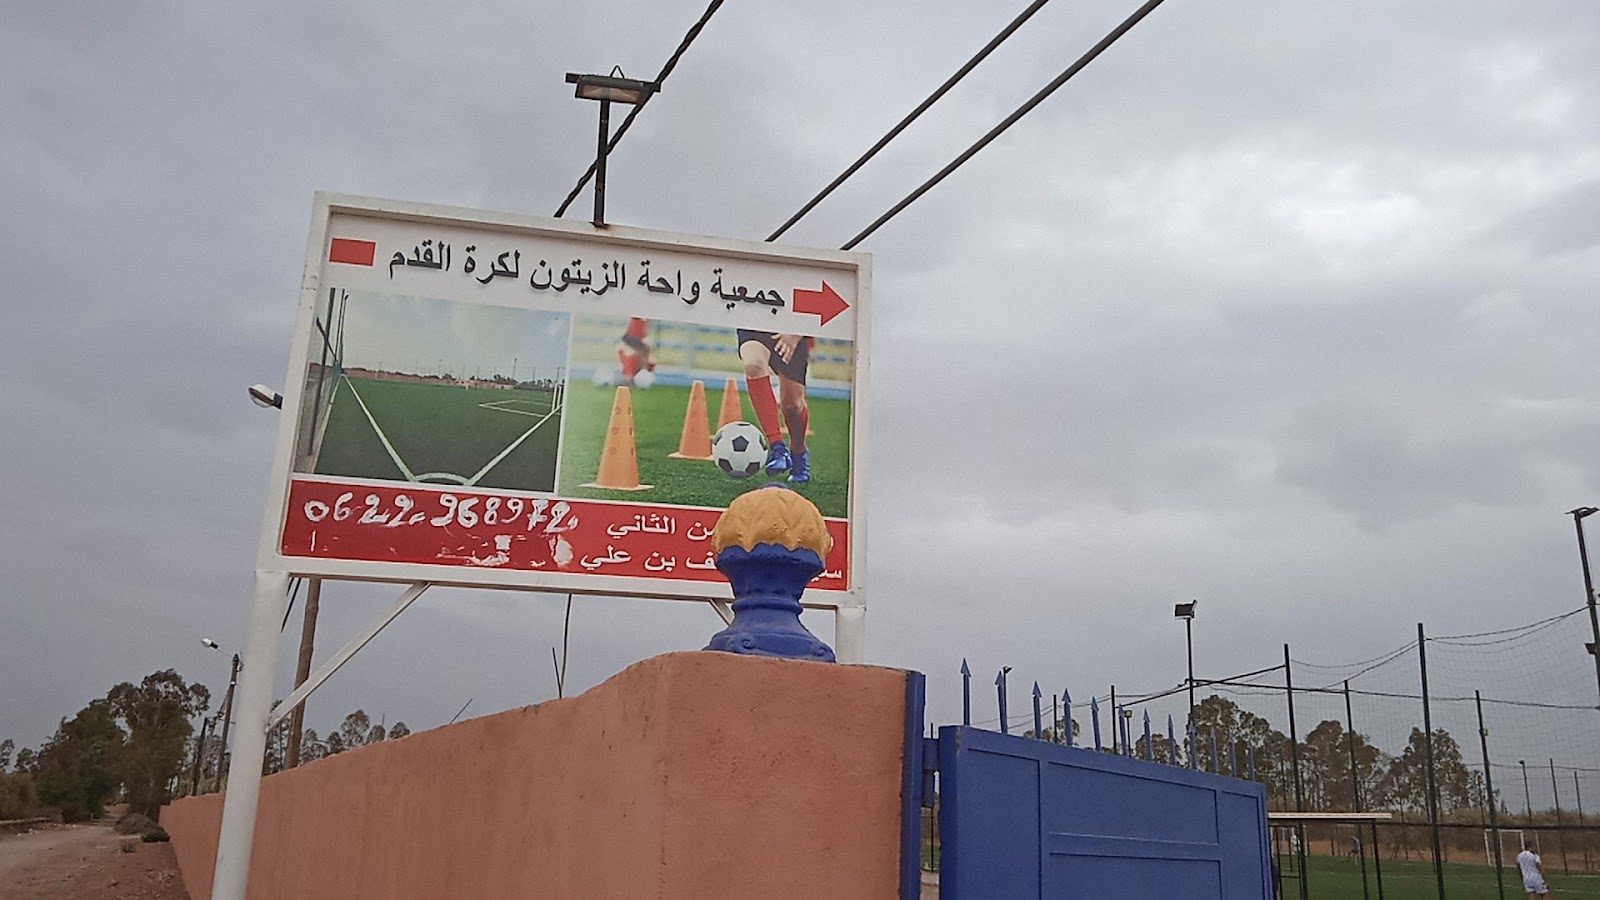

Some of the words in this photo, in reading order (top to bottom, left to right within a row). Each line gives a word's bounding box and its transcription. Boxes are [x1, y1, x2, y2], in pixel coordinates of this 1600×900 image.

[389, 239, 451, 280] القدم
[463, 244, 521, 285] لكرة
[529, 258, 626, 296] الزيتون
[637, 259, 700, 305] واحة
[710, 267, 786, 315] جمعية
[606, 513, 676, 539] الثاني
[580, 545, 632, 571] علي
[644, 551, 676, 572] بن
